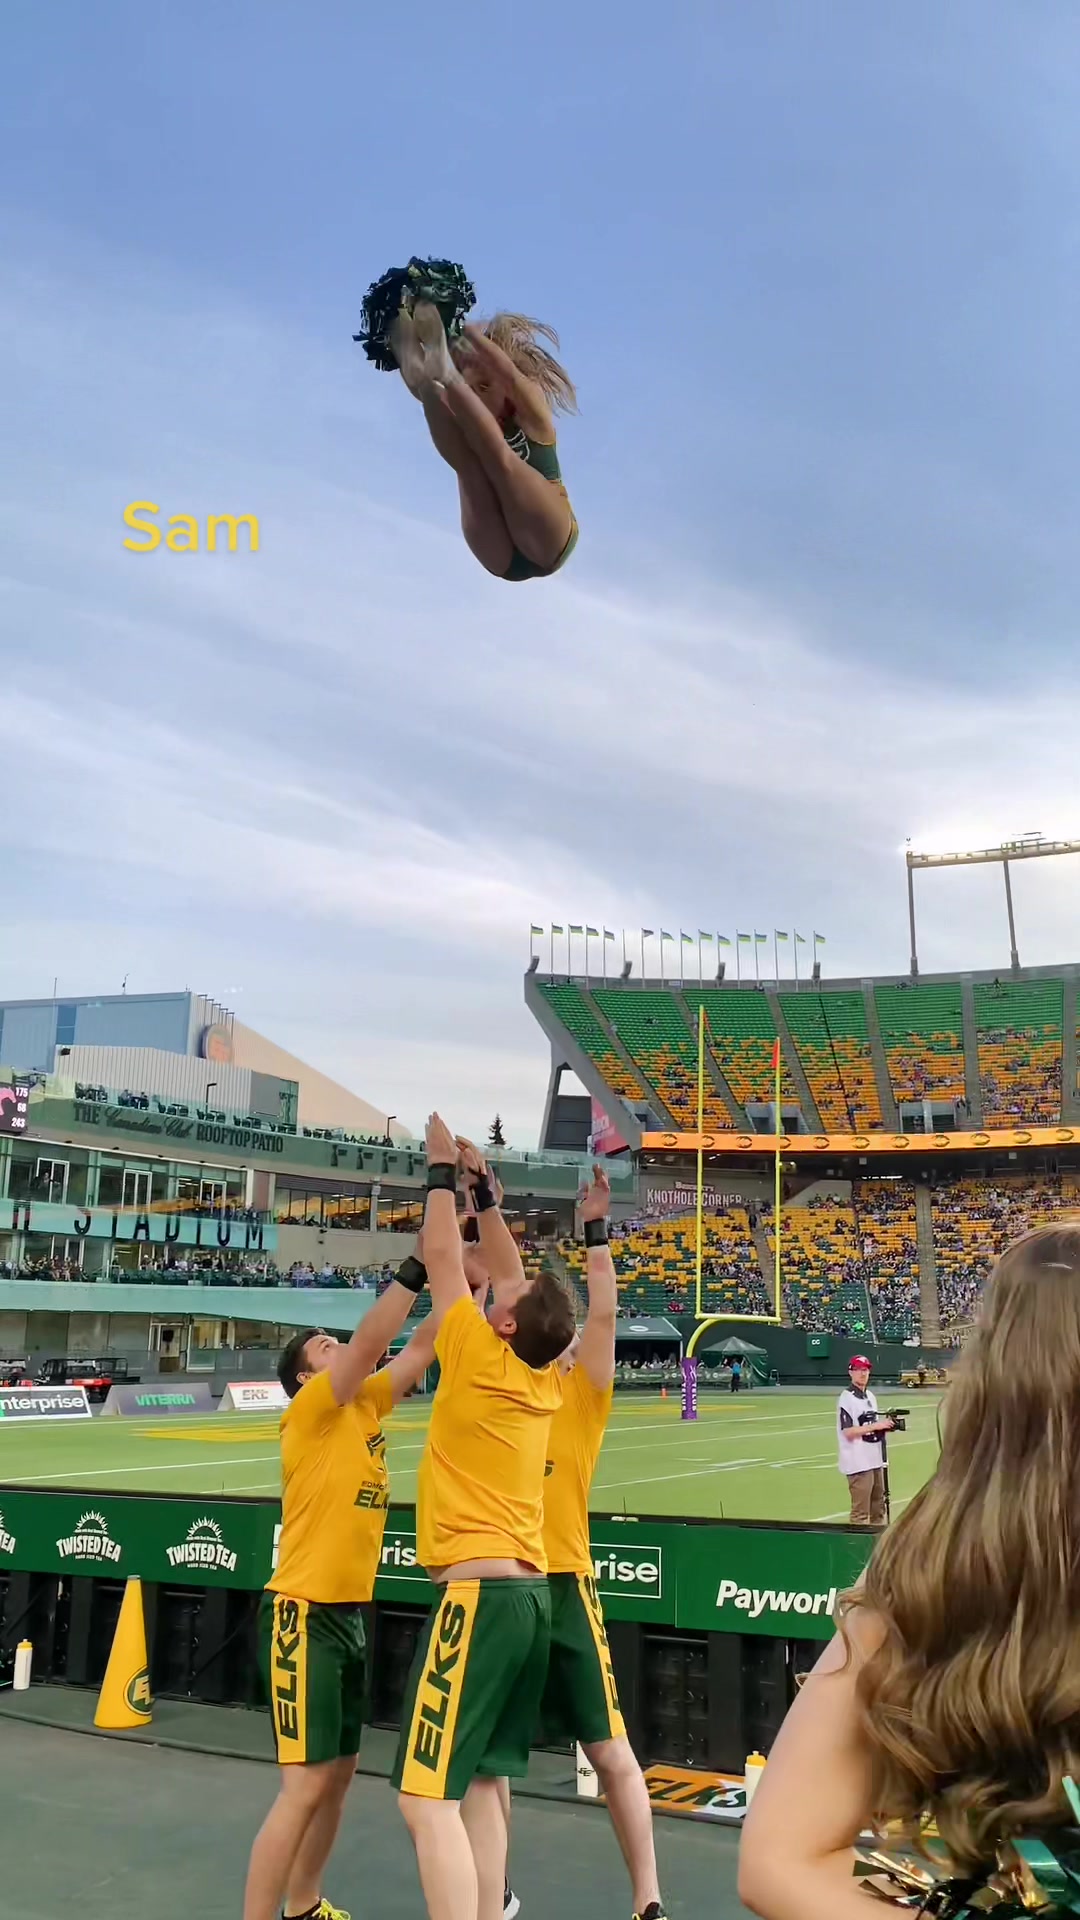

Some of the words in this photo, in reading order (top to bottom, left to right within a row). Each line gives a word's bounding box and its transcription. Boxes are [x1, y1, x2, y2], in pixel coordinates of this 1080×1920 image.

[74, 1102, 100, 1124] THE
[196, 1122, 251, 1148] ROOFTOP
[252, 1135, 283, 1153] PATIO
[56, 1535, 101, 1558] TWISTED
[101, 1536, 121, 1562] TEA
[165, 1542, 215, 1567] TWISTED
[215, 1544, 237, 1572] TEA
[276, 1598, 300, 1741] ELKS
[413, 1600, 466, 1773] ELKS
